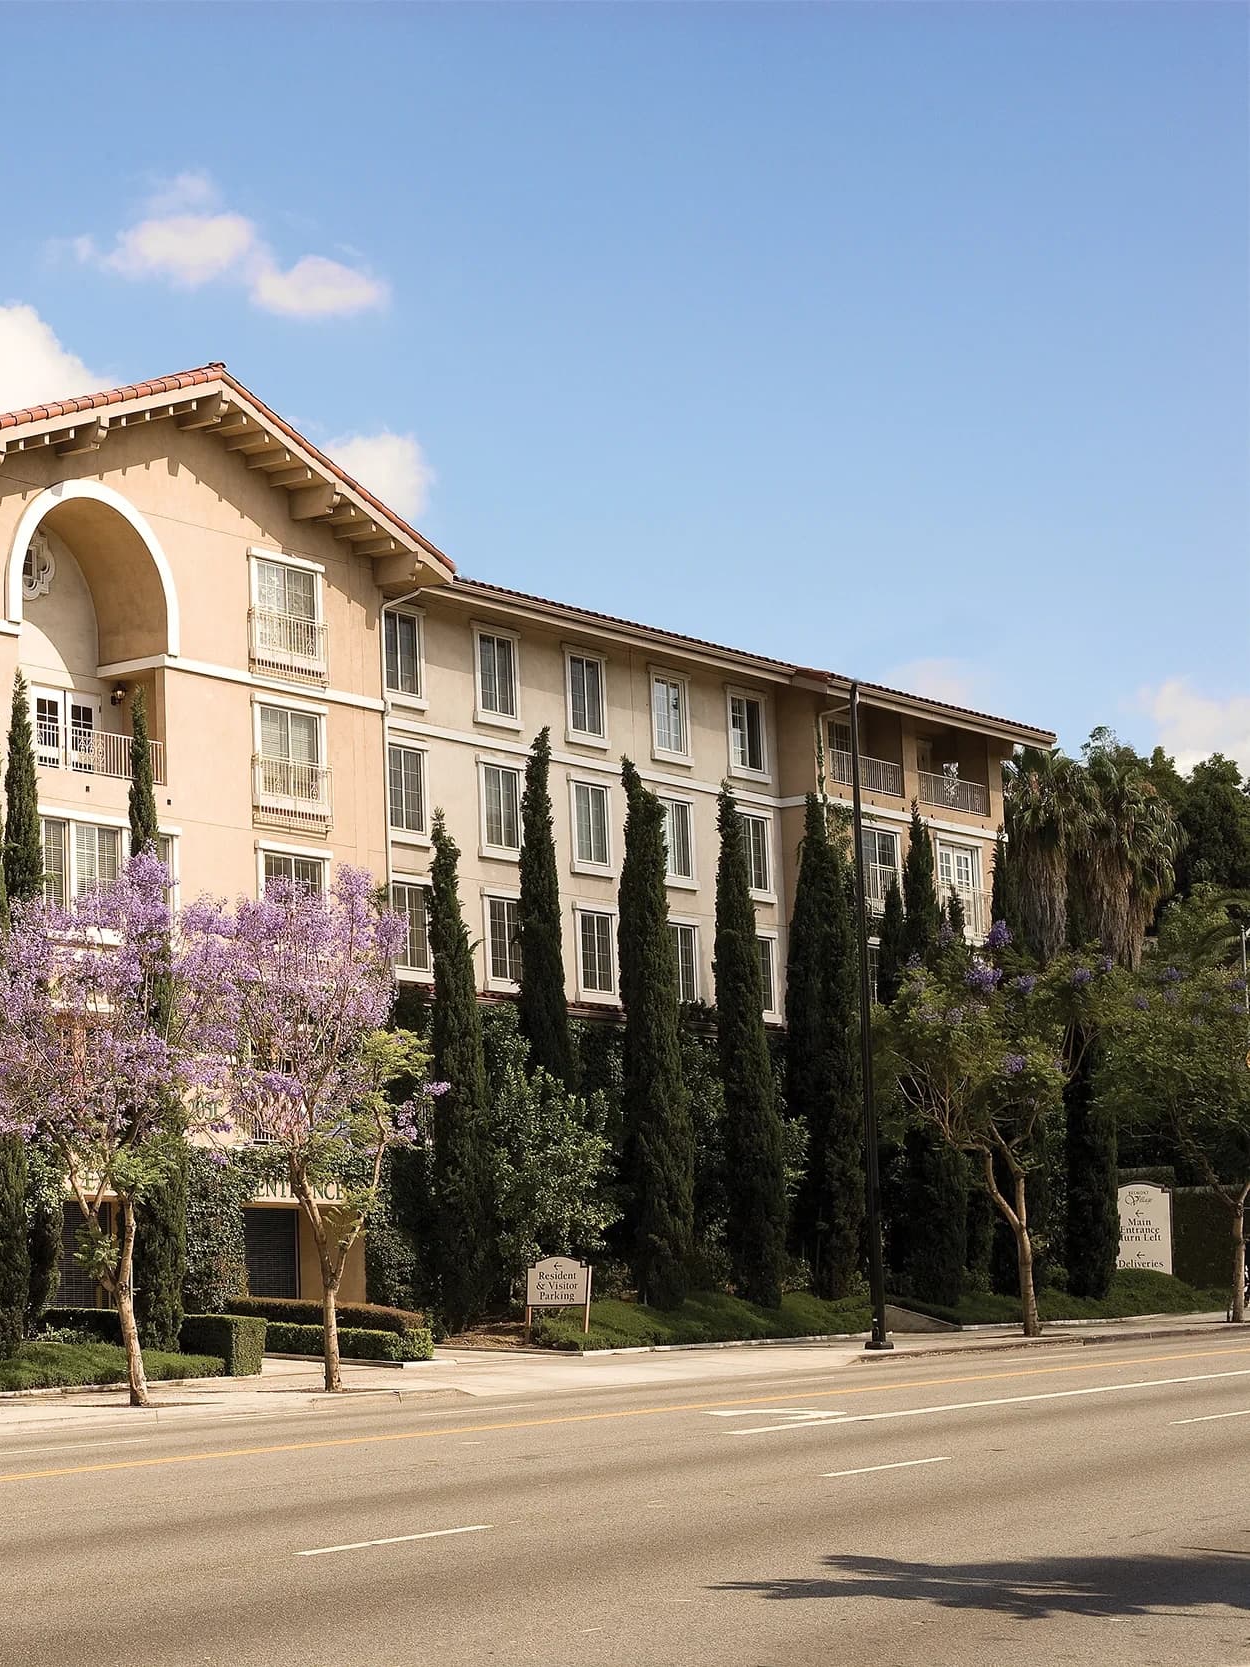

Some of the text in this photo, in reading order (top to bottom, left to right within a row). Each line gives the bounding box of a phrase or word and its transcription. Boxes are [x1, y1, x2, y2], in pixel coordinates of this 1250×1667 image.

[1128, 1218, 1152, 1226] Main
[1120, 1226, 1160, 1234] Entrance
[1144, 1233, 1162, 1242] Left
[1118, 1259, 1165, 1268] Deliveries
[538, 1271, 577, 1280] Resident
[536, 1281, 579, 1290] & Visitor
[539, 1291, 575, 1302] Parking
